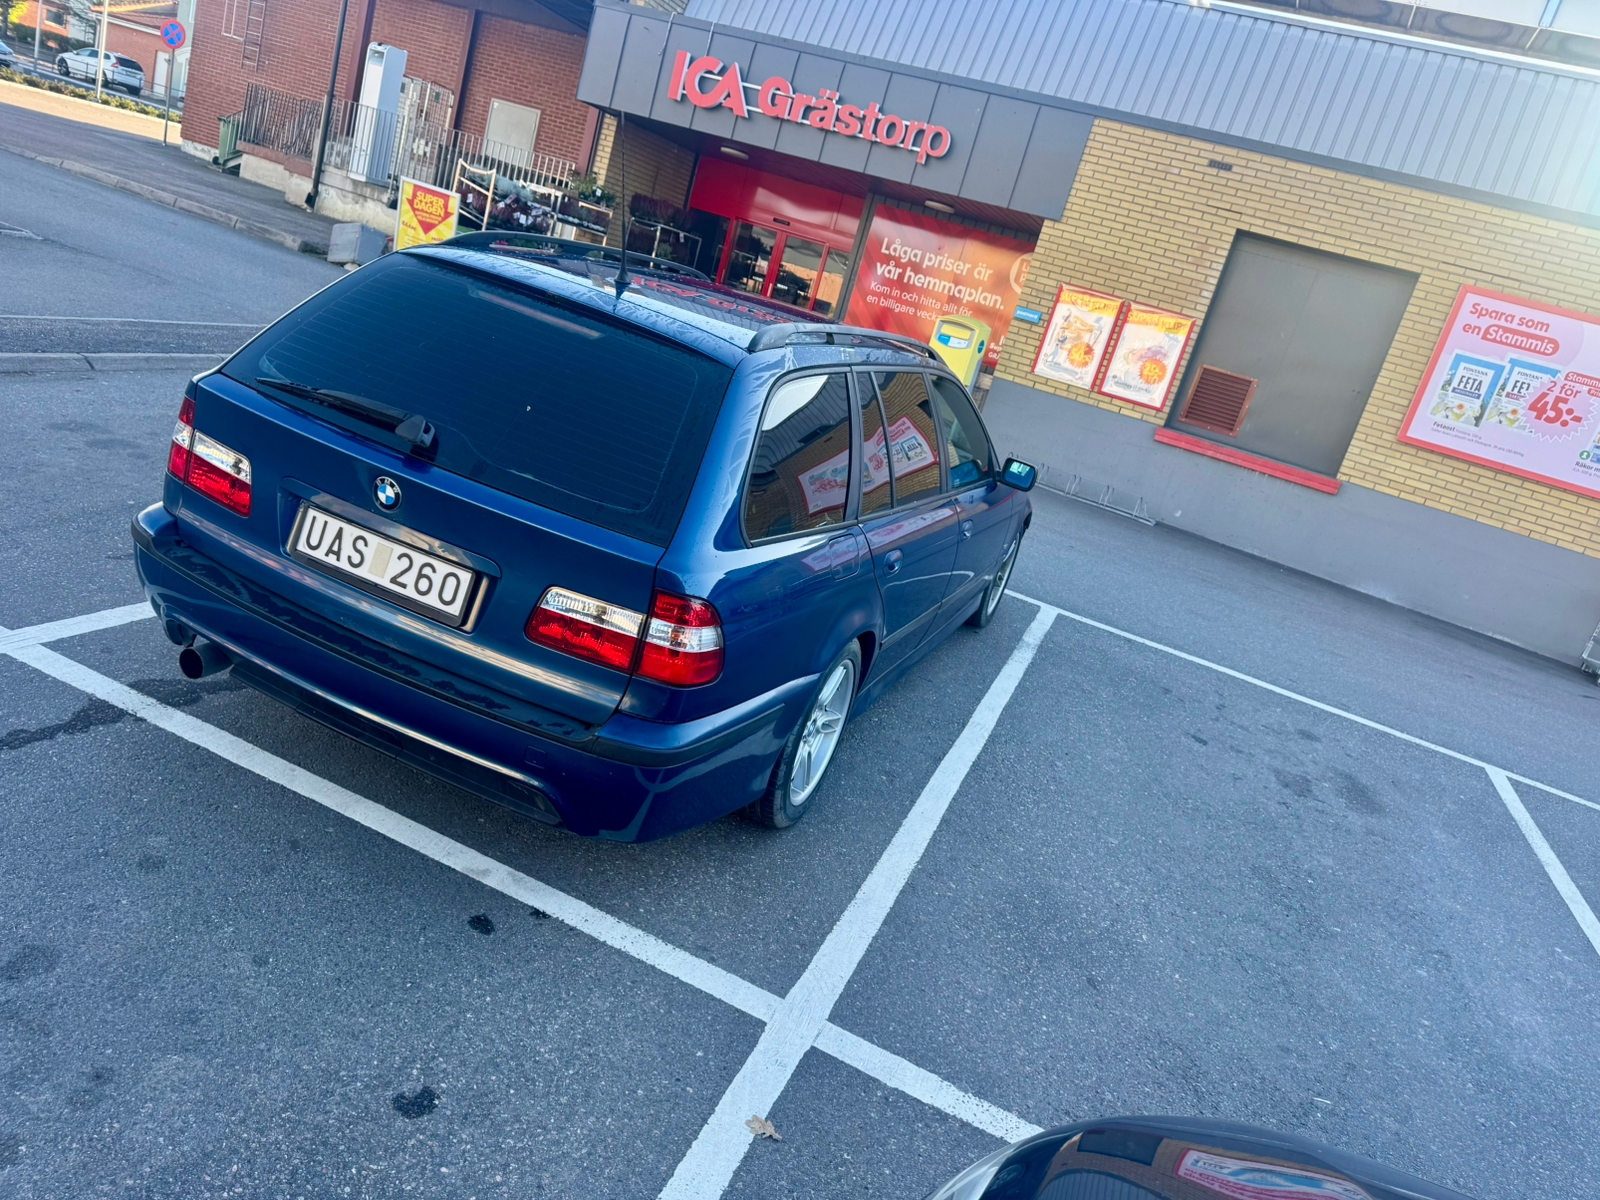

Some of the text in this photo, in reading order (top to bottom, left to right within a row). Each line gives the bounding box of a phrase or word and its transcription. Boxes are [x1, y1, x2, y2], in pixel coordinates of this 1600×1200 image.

[667, 50, 951, 165] ICA Grästorp
[413, 199, 445, 217] DAGEN
[416, 191, 445, 208] SUPER
[881, 237, 922, 263] Låga
[922, 252, 972, 275] priser
[973, 262, 993, 281] är
[876, 260, 902, 280] vår
[903, 267, 1004, 310] hemmaplan.
[866, 294, 939, 321] en billigare veck
[870, 281, 972, 317] Kom in och hitta allt för
[1016, 309, 1038, 320] postnord
[1128, 311, 1159, 323] SUPER
[1469, 302, 1550, 333] Spara som
[1462, 323, 1555, 354] en Stammis
[1463, 366, 1488, 377] FONTANA
[1517, 370, 1543, 380] FONTAN
[1567, 372, 1600, 388] Stamm
[1457, 375, 1483, 393] FETA
[1546, 380, 1582, 398] 2 för
[1527, 391, 1583, 427] 45:-
[1433, 421, 1455, 432] Fetaost
[376, 478, 400, 493] BMW
[305, 515, 461, 606] UAS 260
